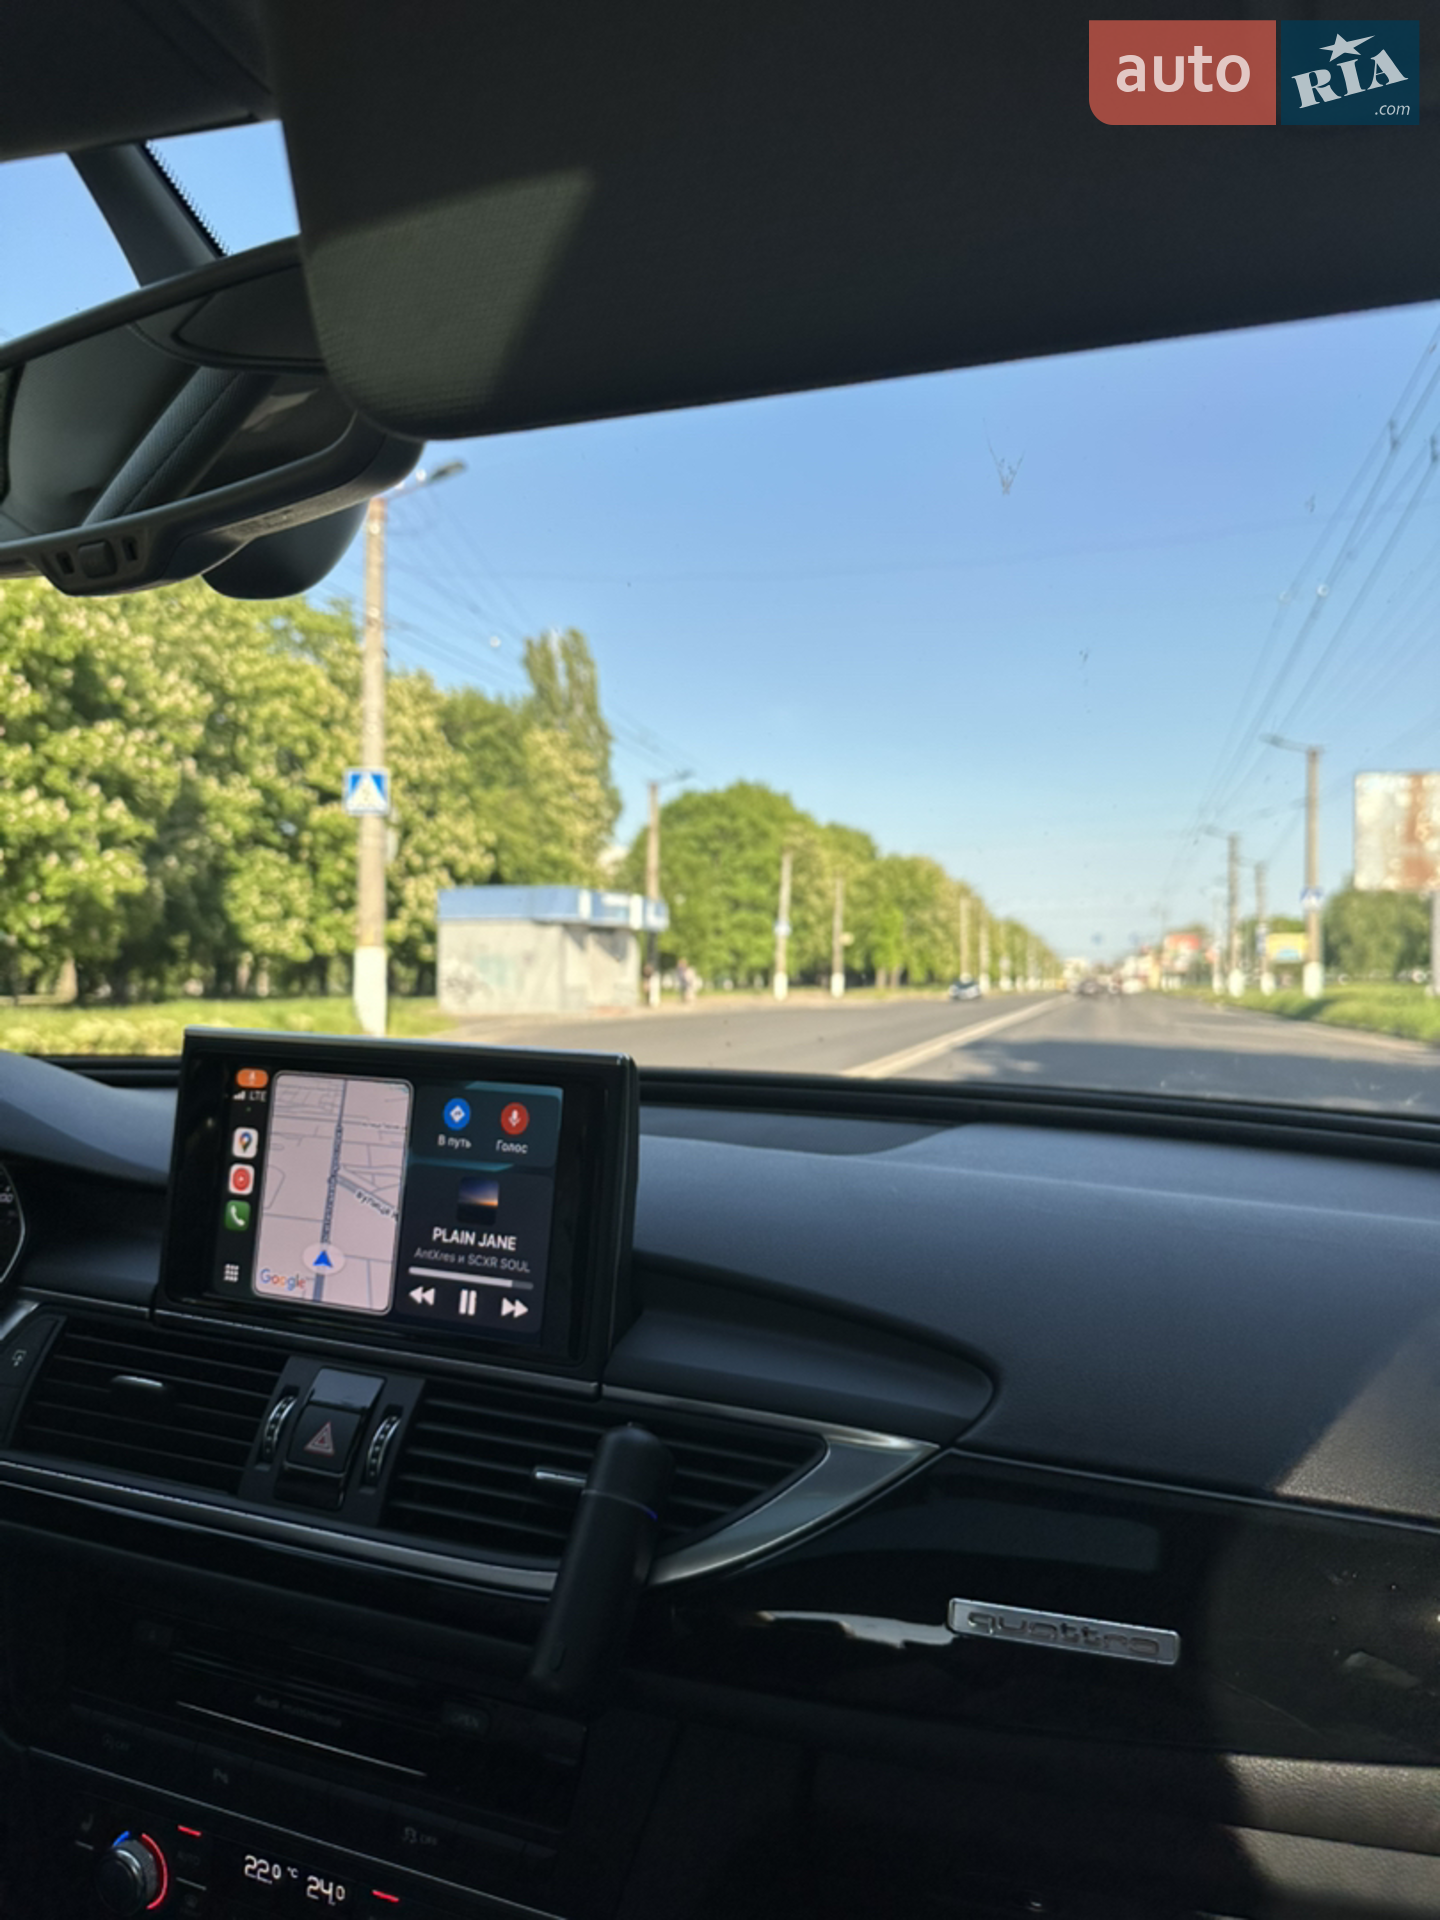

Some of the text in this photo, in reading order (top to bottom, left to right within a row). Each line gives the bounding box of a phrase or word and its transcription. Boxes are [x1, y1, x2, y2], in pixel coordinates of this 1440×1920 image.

[248, 1090, 267, 1103] LTE
[438, 1134, 472, 1150] В путь
[496, 1139, 528, 1154] Голос
[432, 1227, 518, 1251] PLAIN JANE
[467, 1252, 499, 1270] SCXR
[501, 1256, 531, 1273] SOUL
[260, 1268, 306, 1291] Google
[967, 1613, 1160, 1655] quattro
